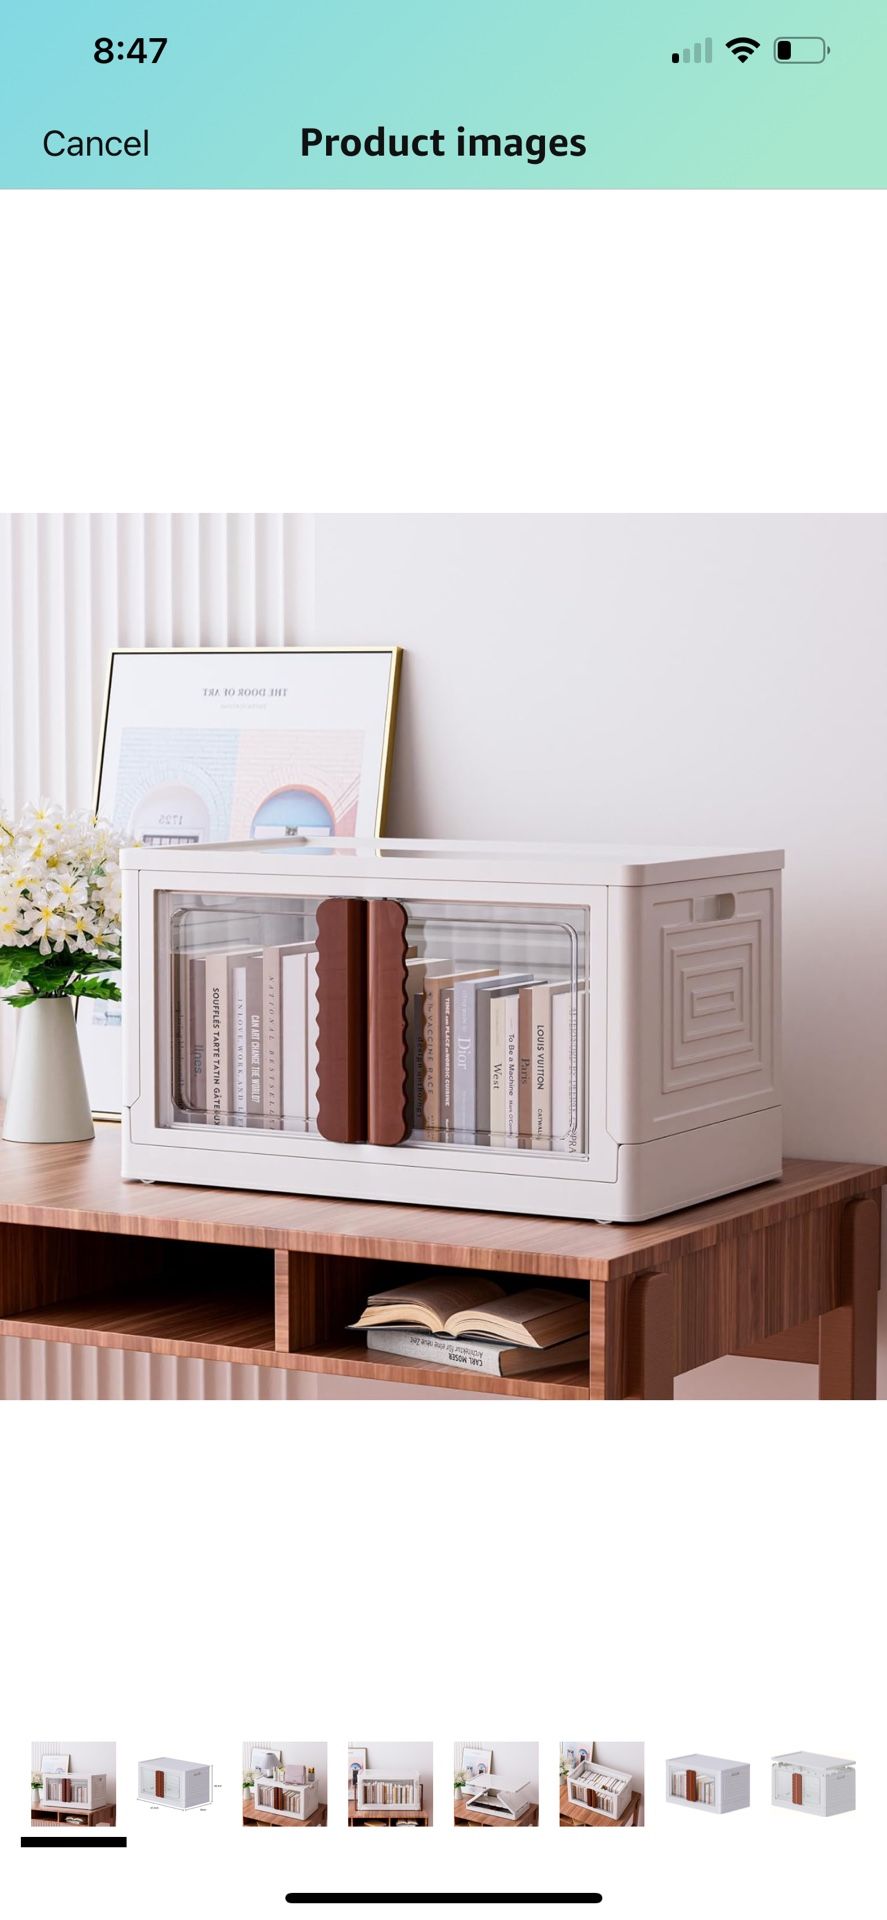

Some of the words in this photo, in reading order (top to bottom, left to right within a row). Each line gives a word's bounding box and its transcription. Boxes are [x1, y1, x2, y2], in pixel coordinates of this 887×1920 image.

[94, 38, 167, 64] 8:47
[44, 130, 148, 156] Cancel
[302, 126, 444, 156] Product
[458, 126, 586, 164] images
[213, 987, 222, 1028] SOUFFLÉS
[251, 1014, 260, 1027] CAN
[213, 1031, 221, 1057] TARTE
[251, 1029, 260, 1040] ART
[508, 1033, 515, 1042] To
[537, 1025, 545, 1051] LOUIS
[251, 1042, 260, 1065] CHANGE
[457, 1036, 471, 1069] Dior
[508, 1045, 515, 1054] Be
[213, 1060, 221, 1084] TATIN
[251, 1067, 260, 1077] THE
[493, 1063, 503, 1090] West
[521, 1058, 531, 1085] Paris
[537, 1053, 545, 1090] VUITTON
[448, 1353, 467, 1363] MOSER
[455, 1347, 484, 1358] Architektur
[469, 1356, 483, 1367] CARL
